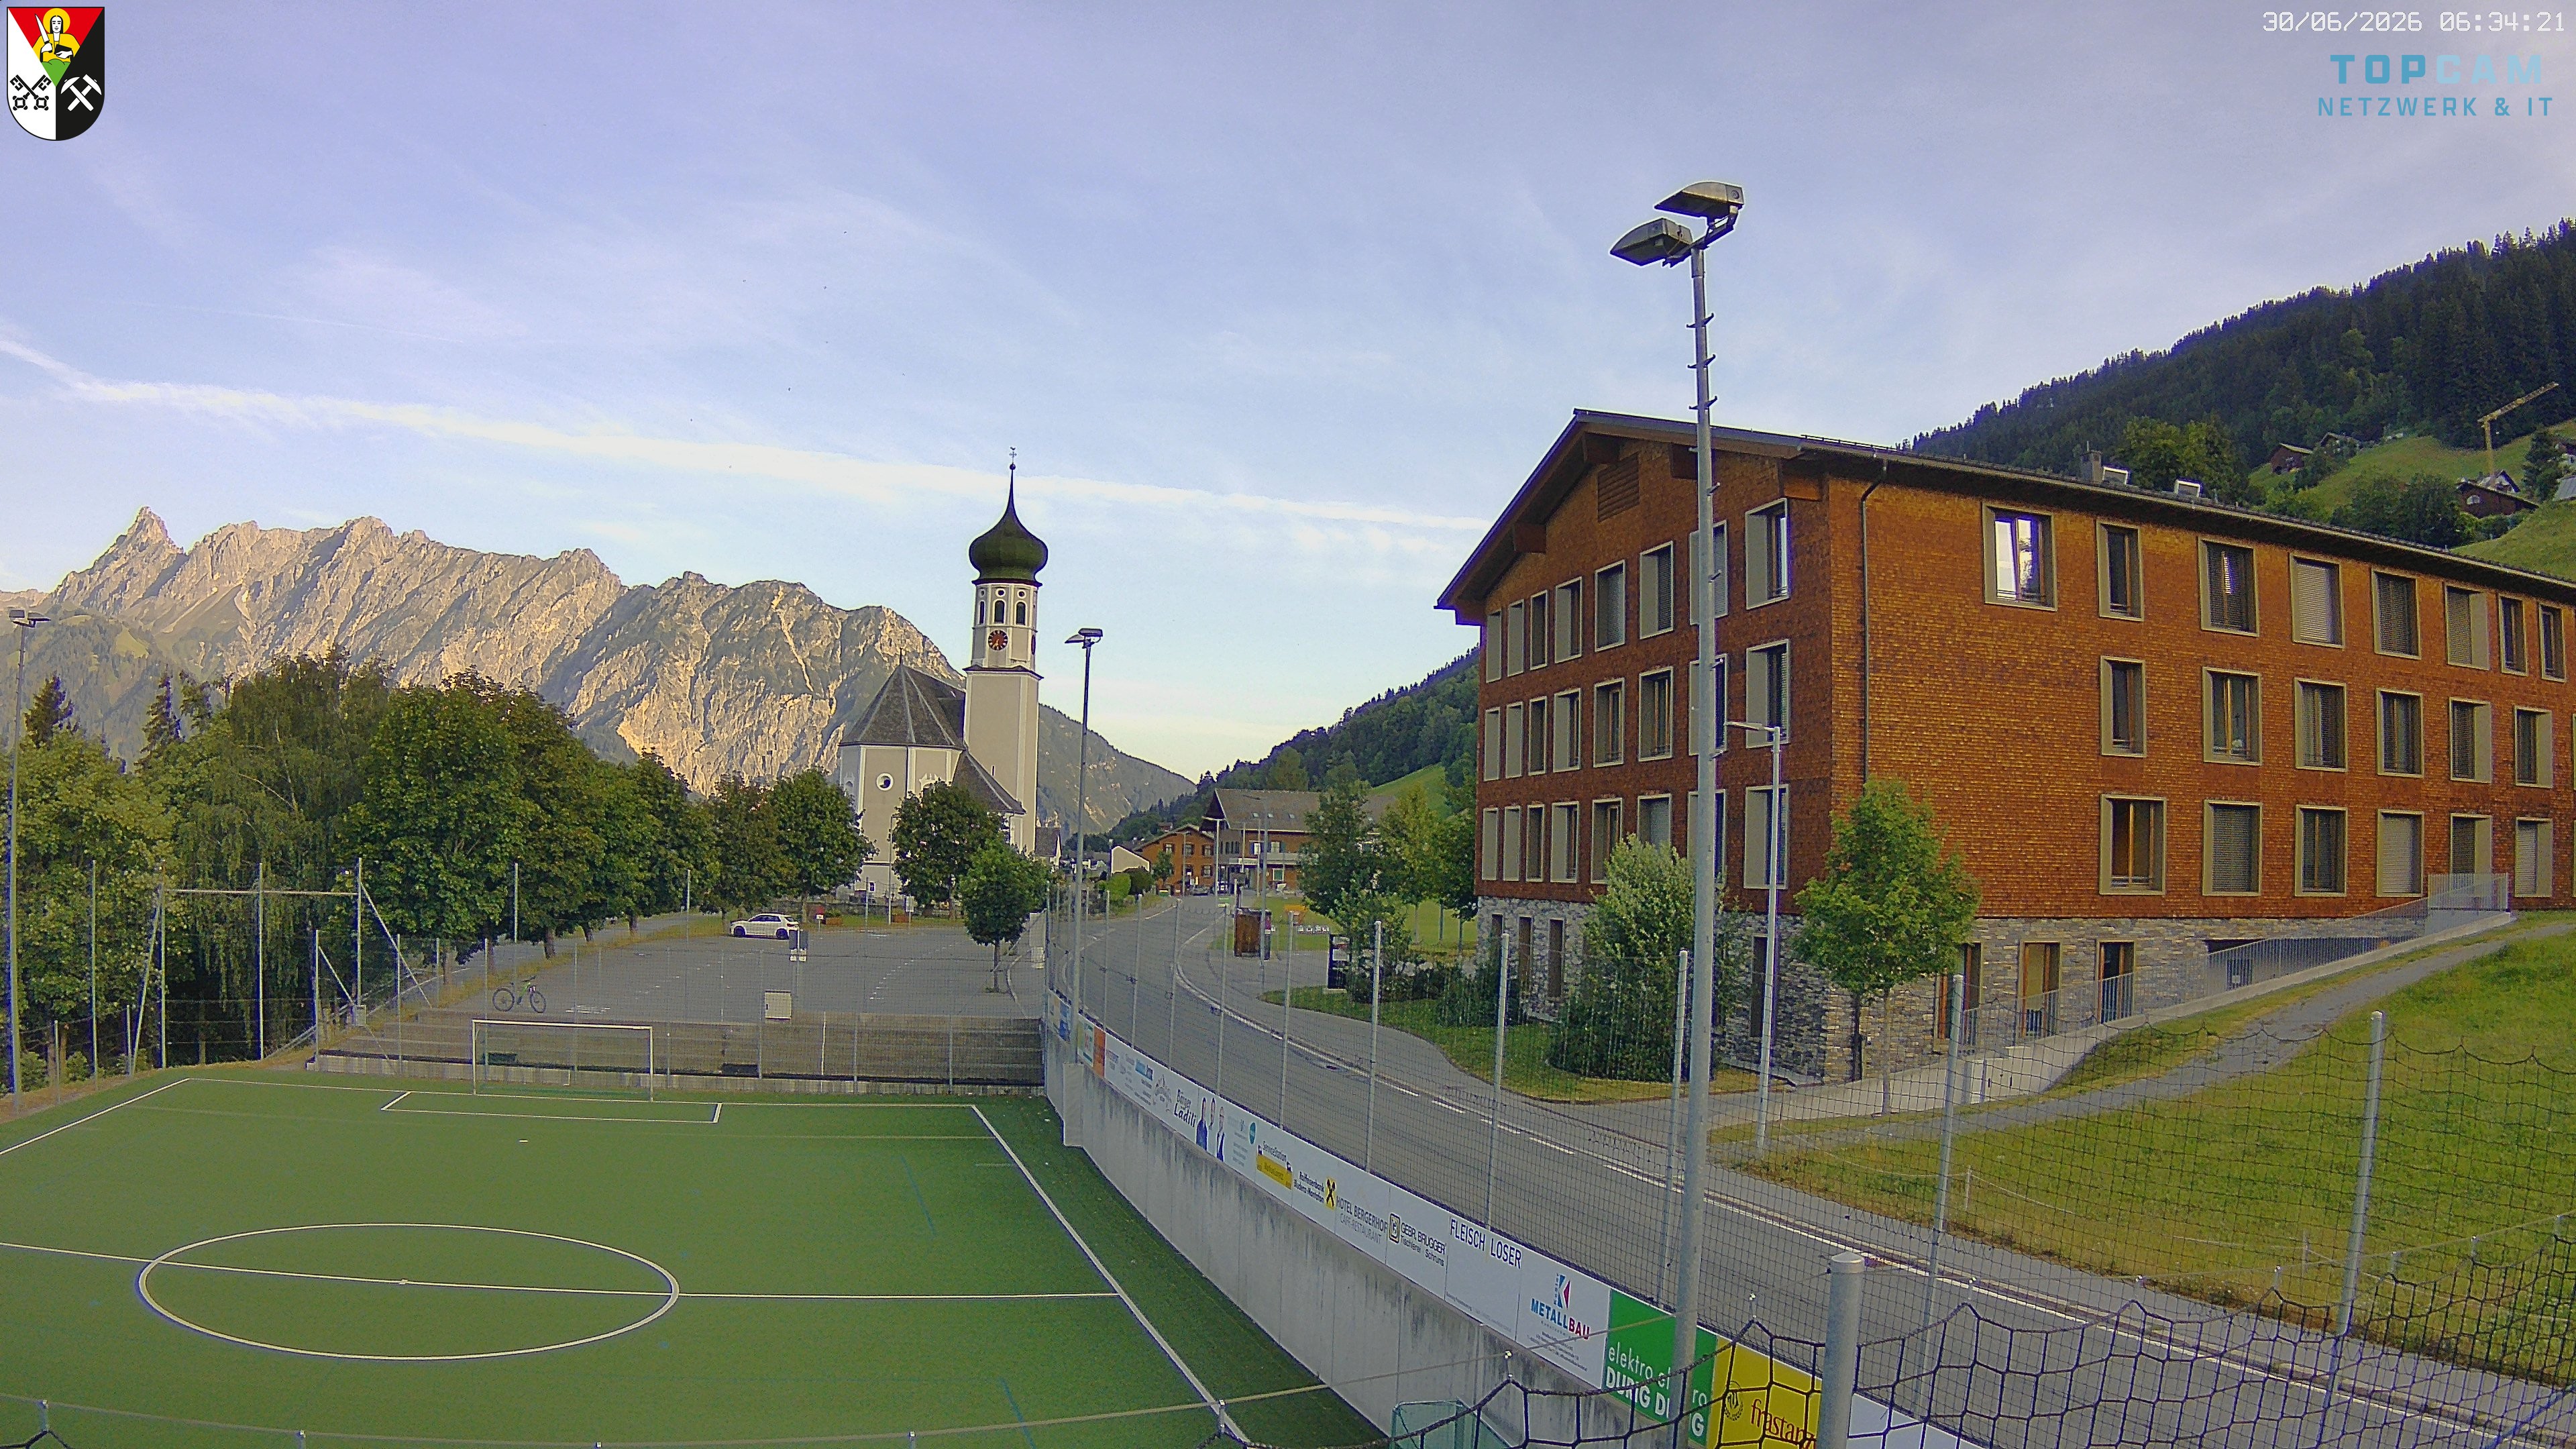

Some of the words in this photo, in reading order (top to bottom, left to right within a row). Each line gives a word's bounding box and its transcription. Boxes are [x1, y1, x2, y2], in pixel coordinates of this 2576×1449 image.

[1336, 1195, 1352, 1215] HOTEL
[1354, 1206, 1388, 1233] BERGERHOF
[1450, 1218, 1486, 1251] FLEISCH
[1490, 1238, 1521, 1269] LOSER
[1531, 1297, 1590, 1340] METALLBAU
[1608, 1342, 1654, 1379] elektro
[1751, 1399, 1816, 1449] frastanz
